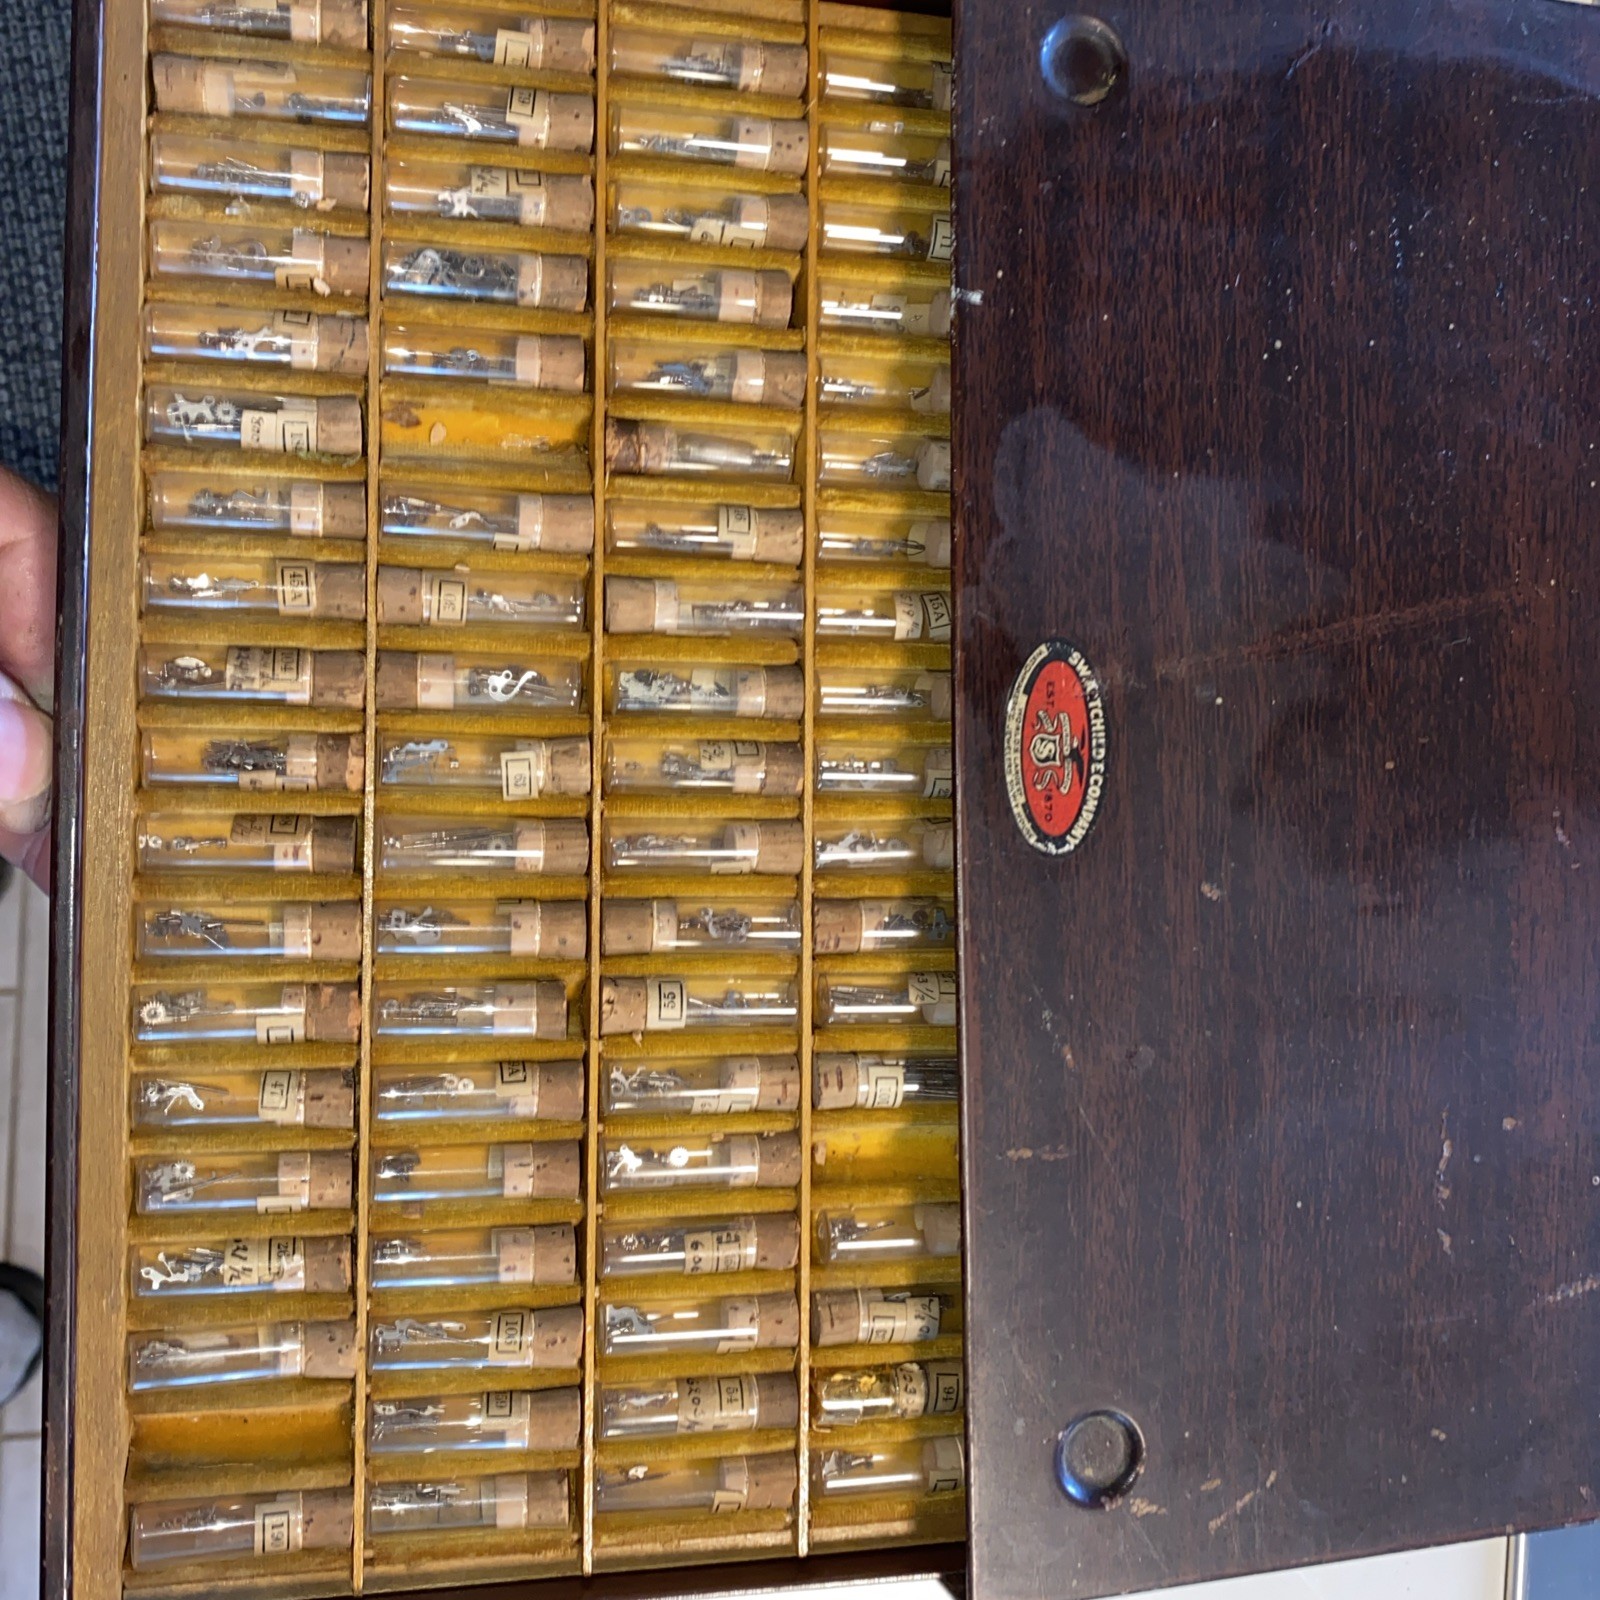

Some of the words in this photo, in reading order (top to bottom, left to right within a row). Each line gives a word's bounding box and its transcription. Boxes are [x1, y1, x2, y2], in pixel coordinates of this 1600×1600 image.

[928, 596, 947, 622] 15A
[1068, 651, 1106, 759] SWATCHILD
[1044, 788, 1053, 822] 1870
[1066, 774, 1104, 845] COMPANY
[662, 991, 677, 1010] 55
[269, 1079, 285, 1096] 47
[504, 1319, 519, 1346] 106
[725, 1386, 738, 1405] 54
[941, 1386, 956, 1403] 94
